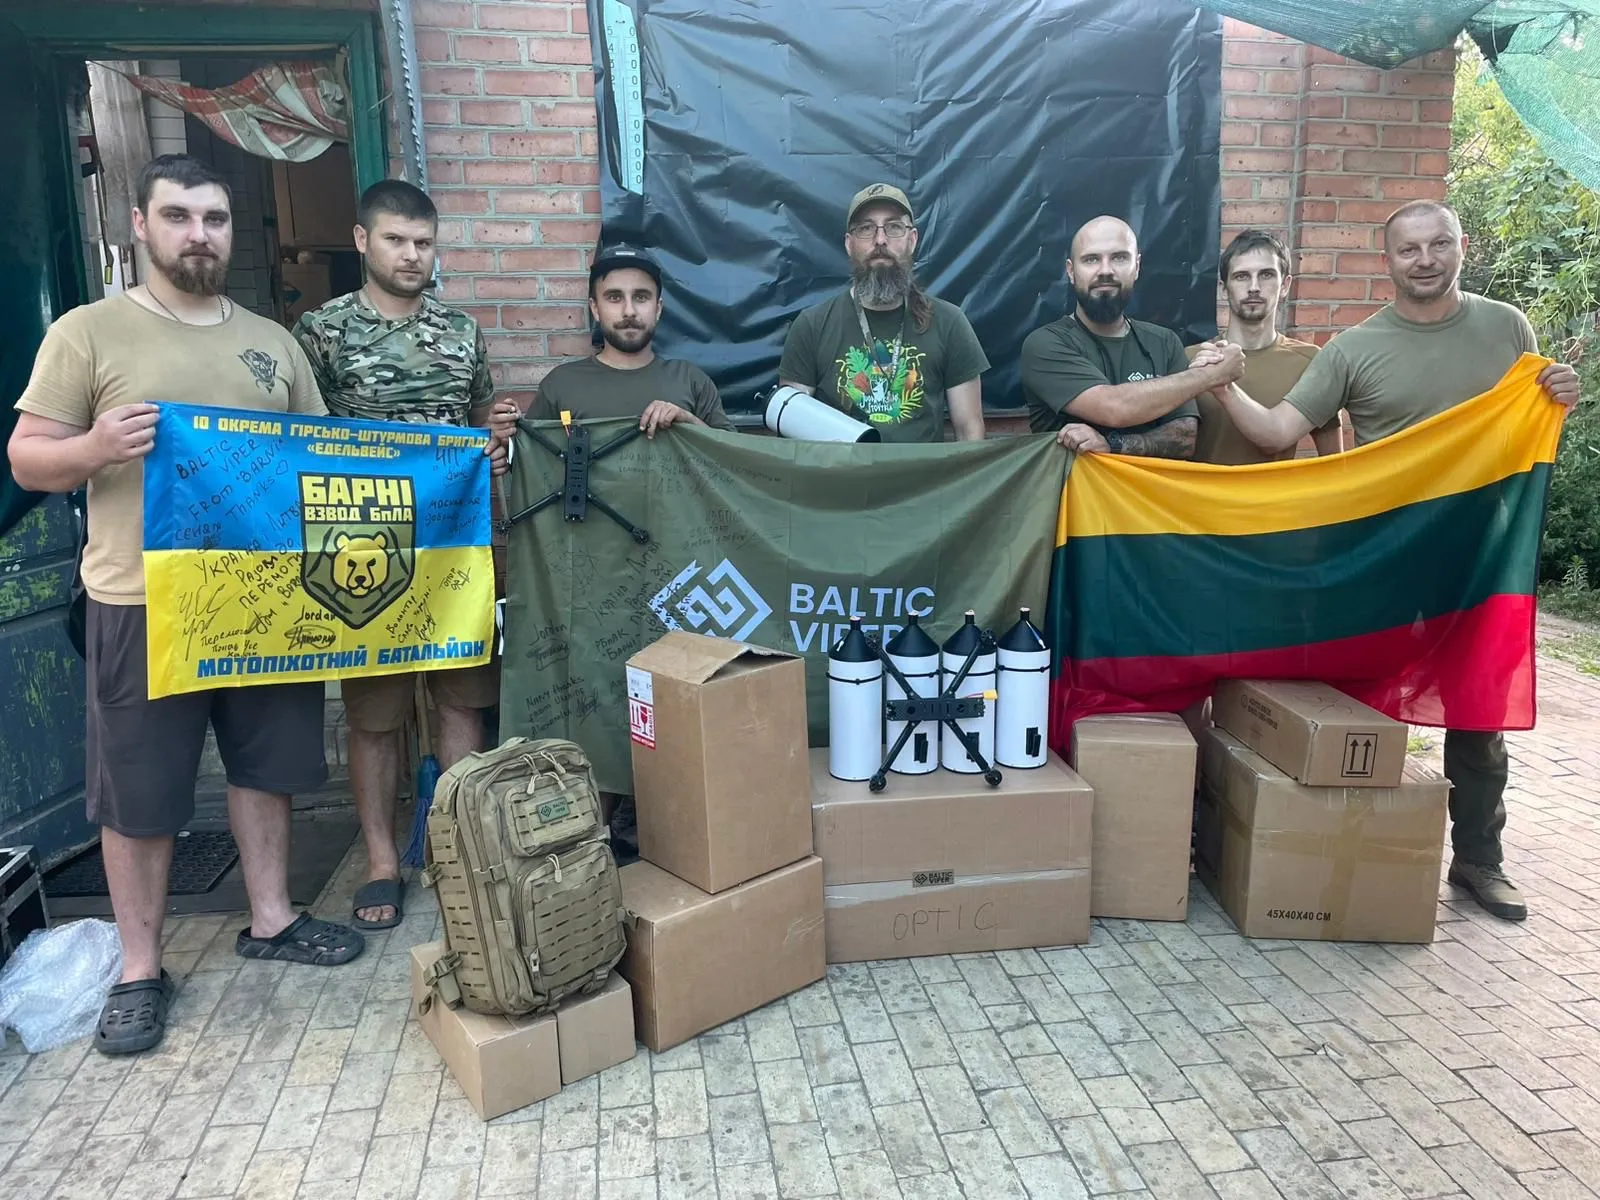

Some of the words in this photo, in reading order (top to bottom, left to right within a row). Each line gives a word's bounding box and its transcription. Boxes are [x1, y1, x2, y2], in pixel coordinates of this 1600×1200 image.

[193, 415, 209, 430] 10
[218, 417, 282, 435] ОКРЕМА
[290, 424, 431, 446] ГІРСЬКО-ШТУРМОВА
[176, 439, 232, 480] BALTIC
[220, 438, 260, 473] VIPER
[302, 476, 412, 506] БАРНІ
[304, 506, 361, 521] ВЗВОД
[370, 507, 413, 521] БпЛА
[789, 582, 936, 617] BALTIC
[789, 620, 904, 653] VIPR
[197, 645, 367, 678] МОТОПІХОТНИЙ
[377, 637, 484, 665] БАТАЛЬЙОН
[892, 901, 1000, 941] OPTIC
[1266, 908, 1314, 921] 45X40X40
[1315, 911, 1332, 921] CM
